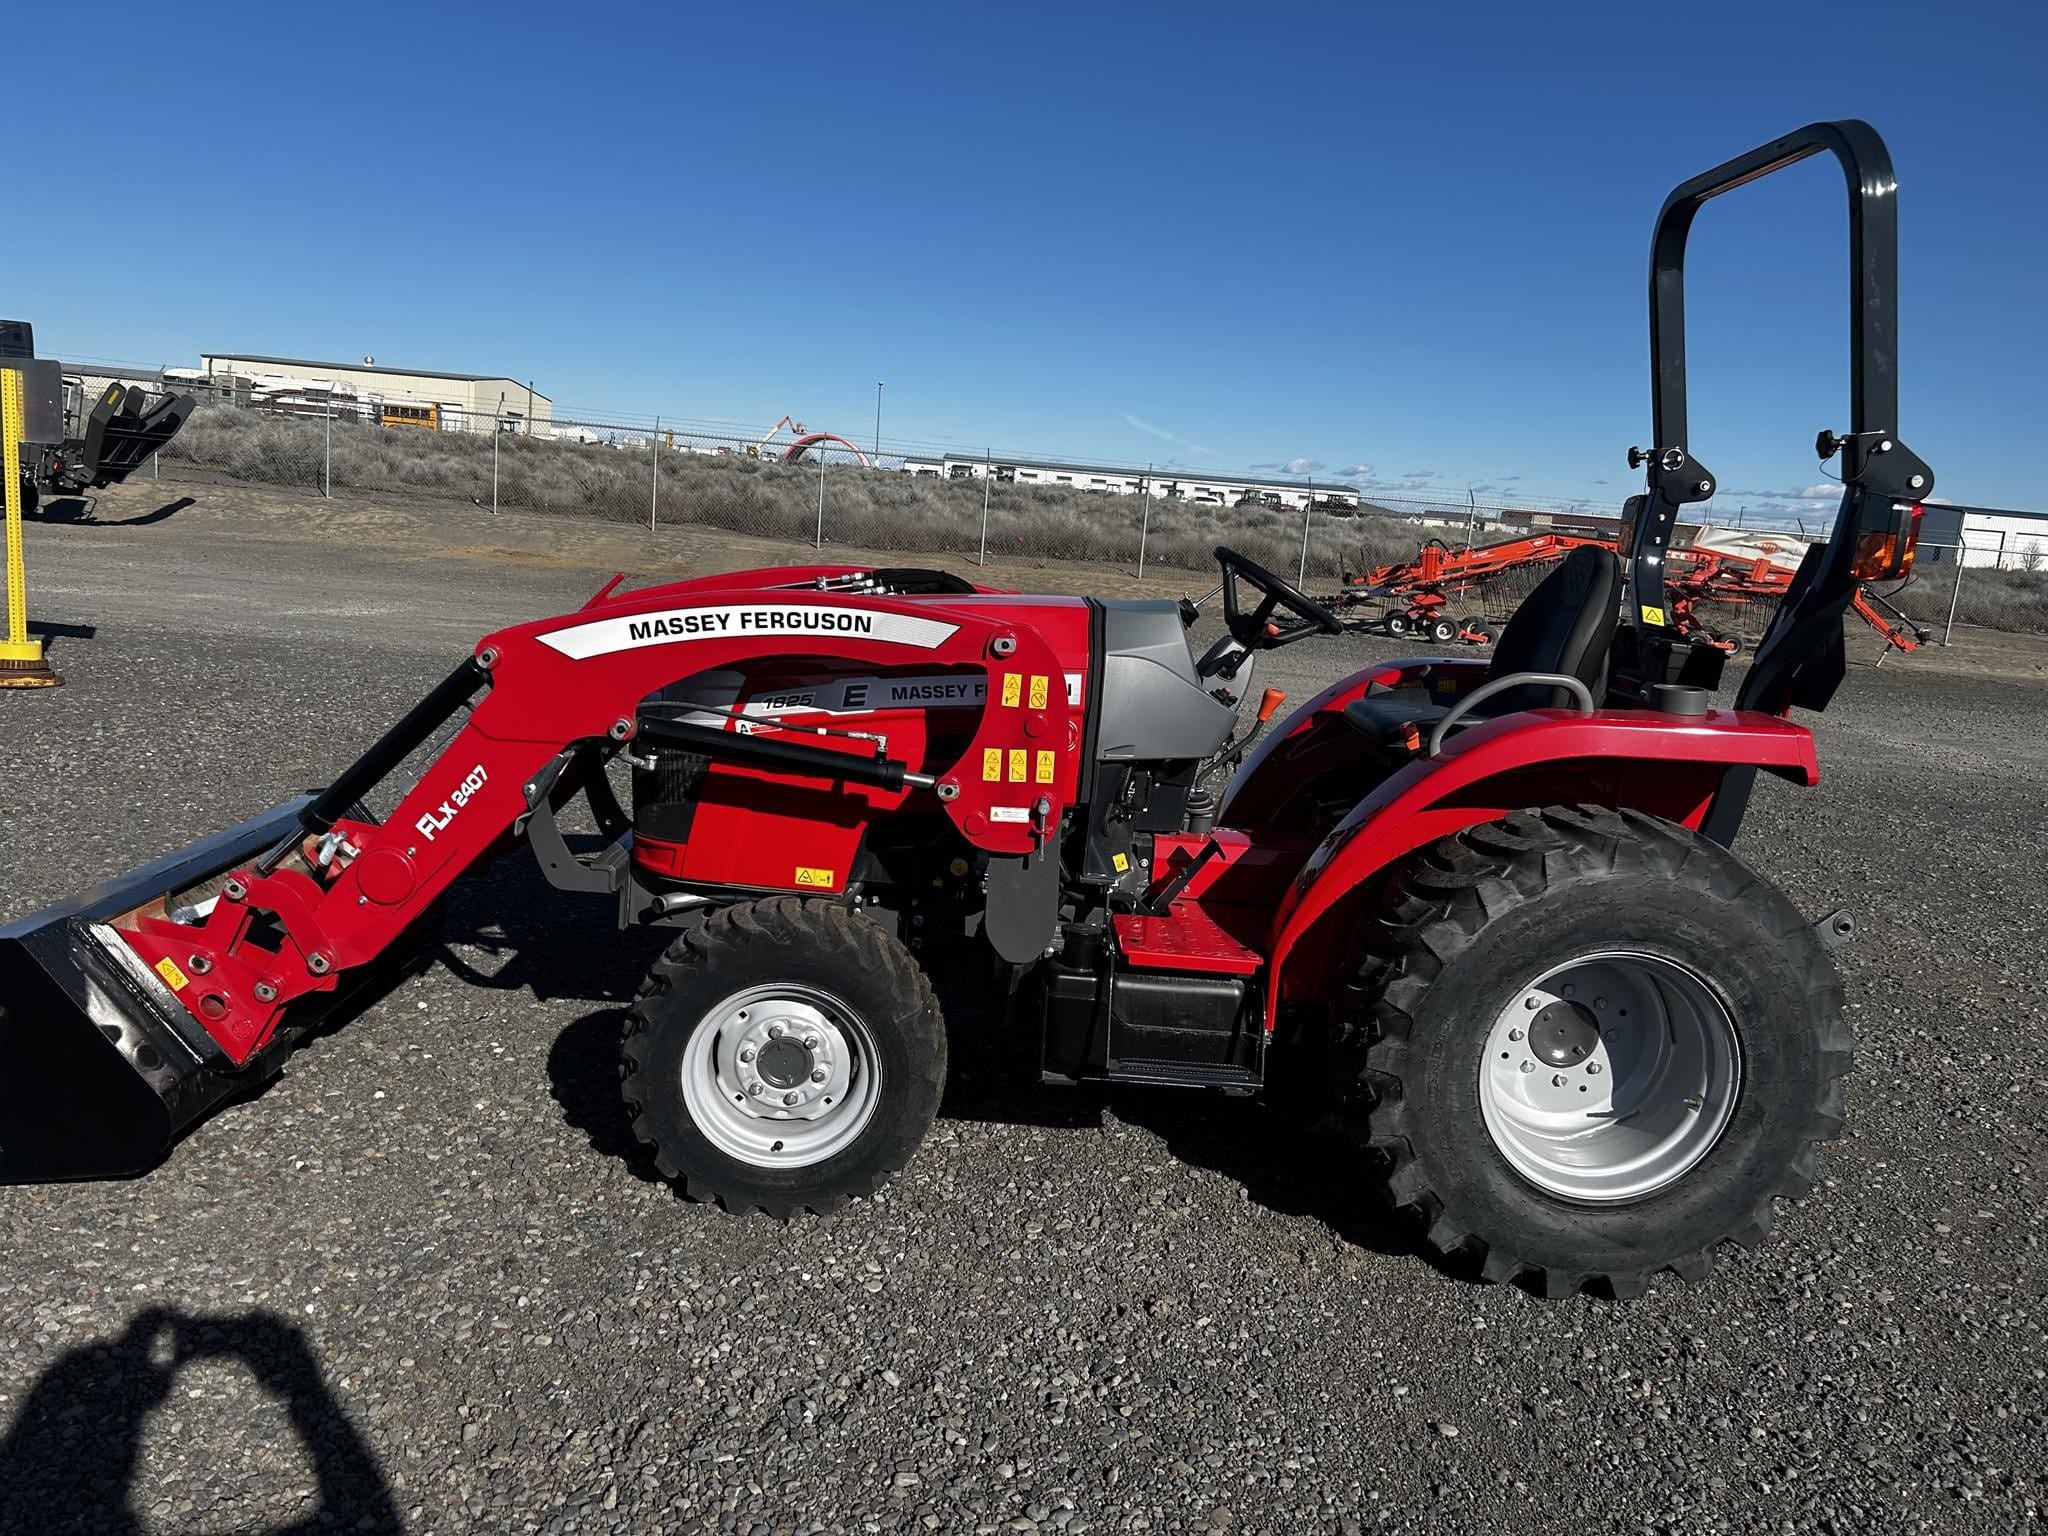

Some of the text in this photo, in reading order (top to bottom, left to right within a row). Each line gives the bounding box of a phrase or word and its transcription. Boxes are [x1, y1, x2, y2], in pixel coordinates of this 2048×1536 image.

[629, 611, 872, 640] MASSEY FERGUSON
[762, 694, 815, 710] 1825
[842, 684, 869, 707] E
[891, 684, 968, 700] MASSEY
[450, 764, 488, 808] 2407
